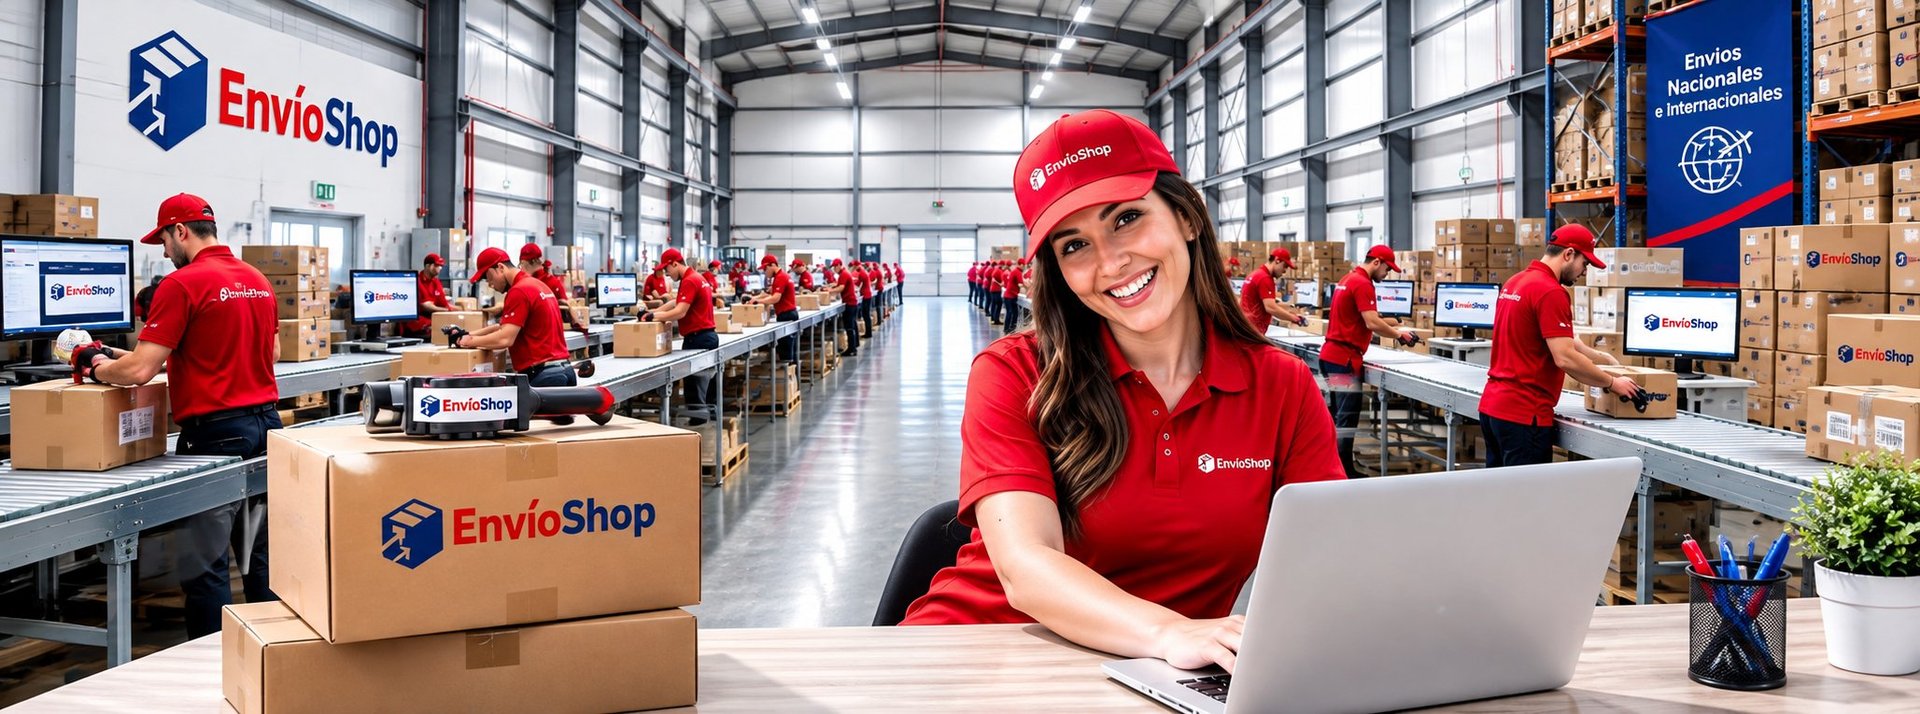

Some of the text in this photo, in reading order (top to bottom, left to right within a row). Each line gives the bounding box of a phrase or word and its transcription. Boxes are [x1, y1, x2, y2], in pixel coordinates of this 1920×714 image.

[1684, 47, 1741, 71] Envios
[1667, 66, 1763, 97] Nacionales
[1655, 86, 1783, 118] e Internacionales
[219, 67, 398, 168] EnvíoShop
[1821, 252, 1881, 267] EnvíoShop
[1661, 317, 1718, 331] EnvíoShop
[1855, 348, 1914, 366] EnvíoShop
[442, 397, 513, 414] EnvíoShop
[453, 498, 656, 545] EnvíoShop
